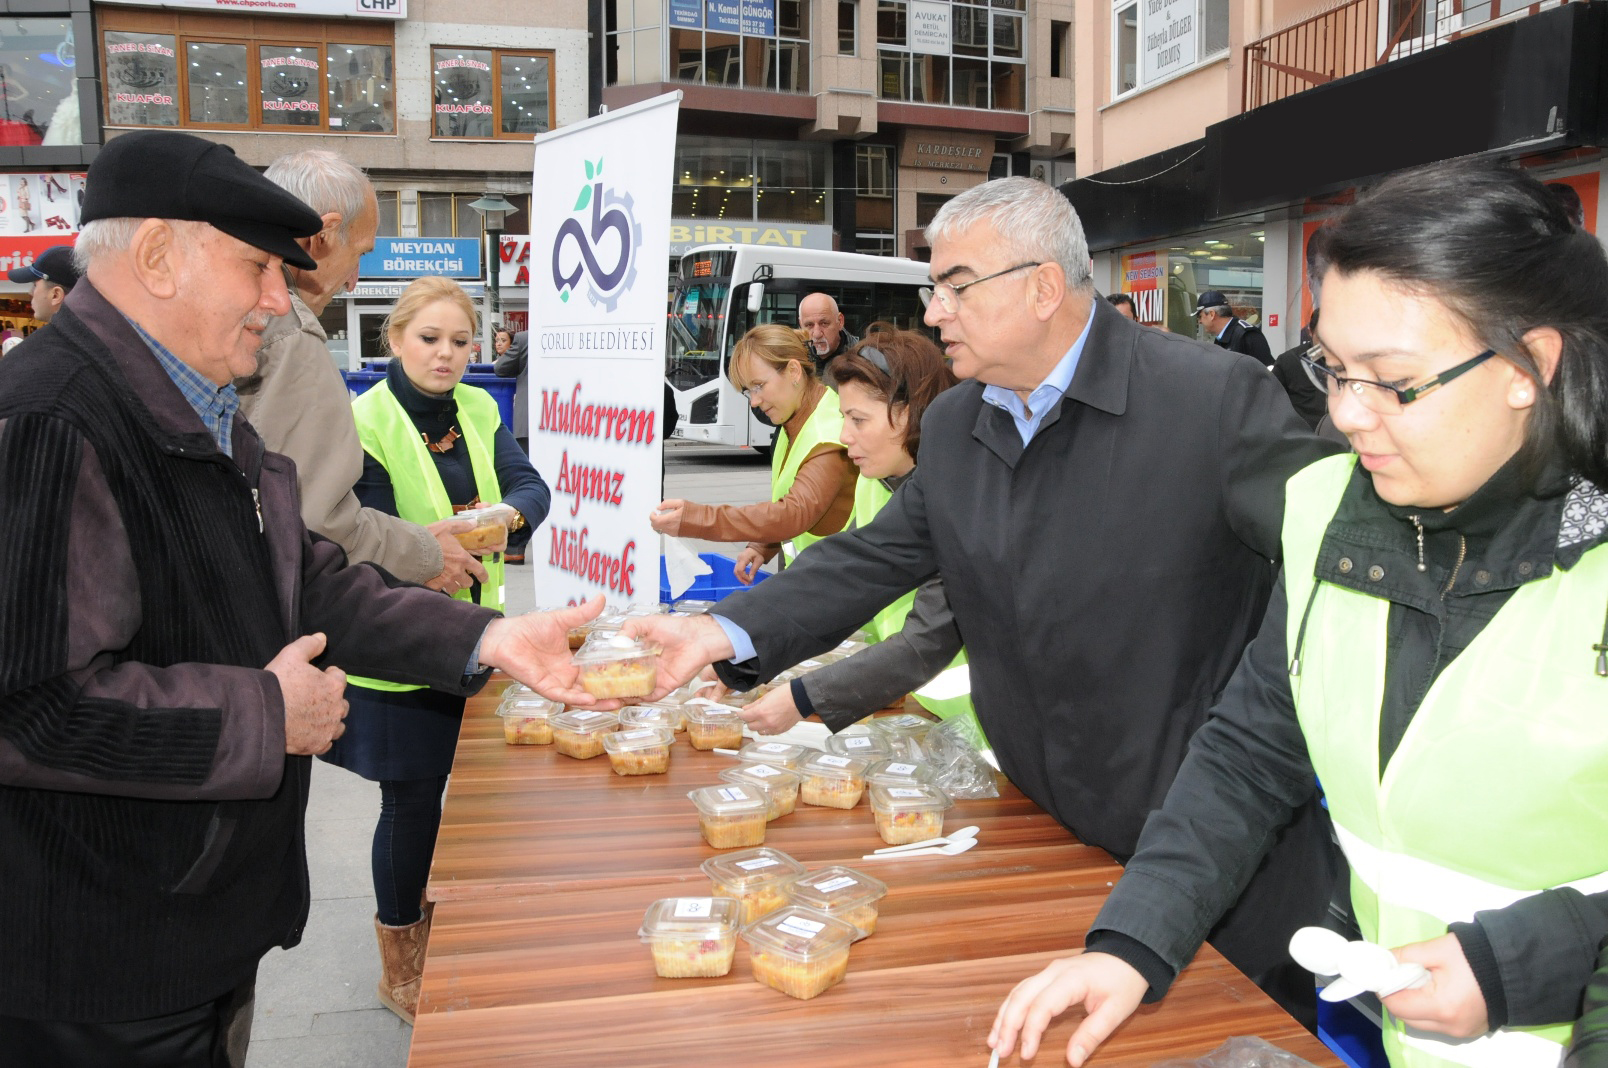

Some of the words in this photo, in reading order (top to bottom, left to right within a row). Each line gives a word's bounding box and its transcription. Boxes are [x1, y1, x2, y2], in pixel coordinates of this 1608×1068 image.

[360, 0, 397, 10] CHP
[718, 5, 739, 16] Kemal
[743, 5, 773, 19] GÜNGÖR
[915, 12, 948, 22] AVUKAT
[923, 23, 940, 31] BETÜL
[914, 29, 948, 39] DEMİRCAN
[108, 43, 137, 54] TANER
[138, 44, 145, 53] &
[261, 57, 286, 68] TANER
[437, 59, 461, 69] TANER
[116, 92, 173, 105] KUAFÖR
[263, 100, 319, 111] KUAFÖR
[436, 103, 492, 114] KUAFÖR
[917, 143, 982, 158] KARDEŞLER
[390, 242, 455, 255] MEYDAN
[383, 257, 463, 275] BÖREKÇİSİ
[1126, 271, 1138, 281] NEW
[1140, 266, 1164, 280] SEASON
[541, 333, 575, 353] ÇORLU
[579, 328, 654, 350] BELEDİYESİ
[539, 383, 655, 445] Muharrem
[556, 451, 624, 516] Ayınız
[549, 526, 636, 596] Mübarek
